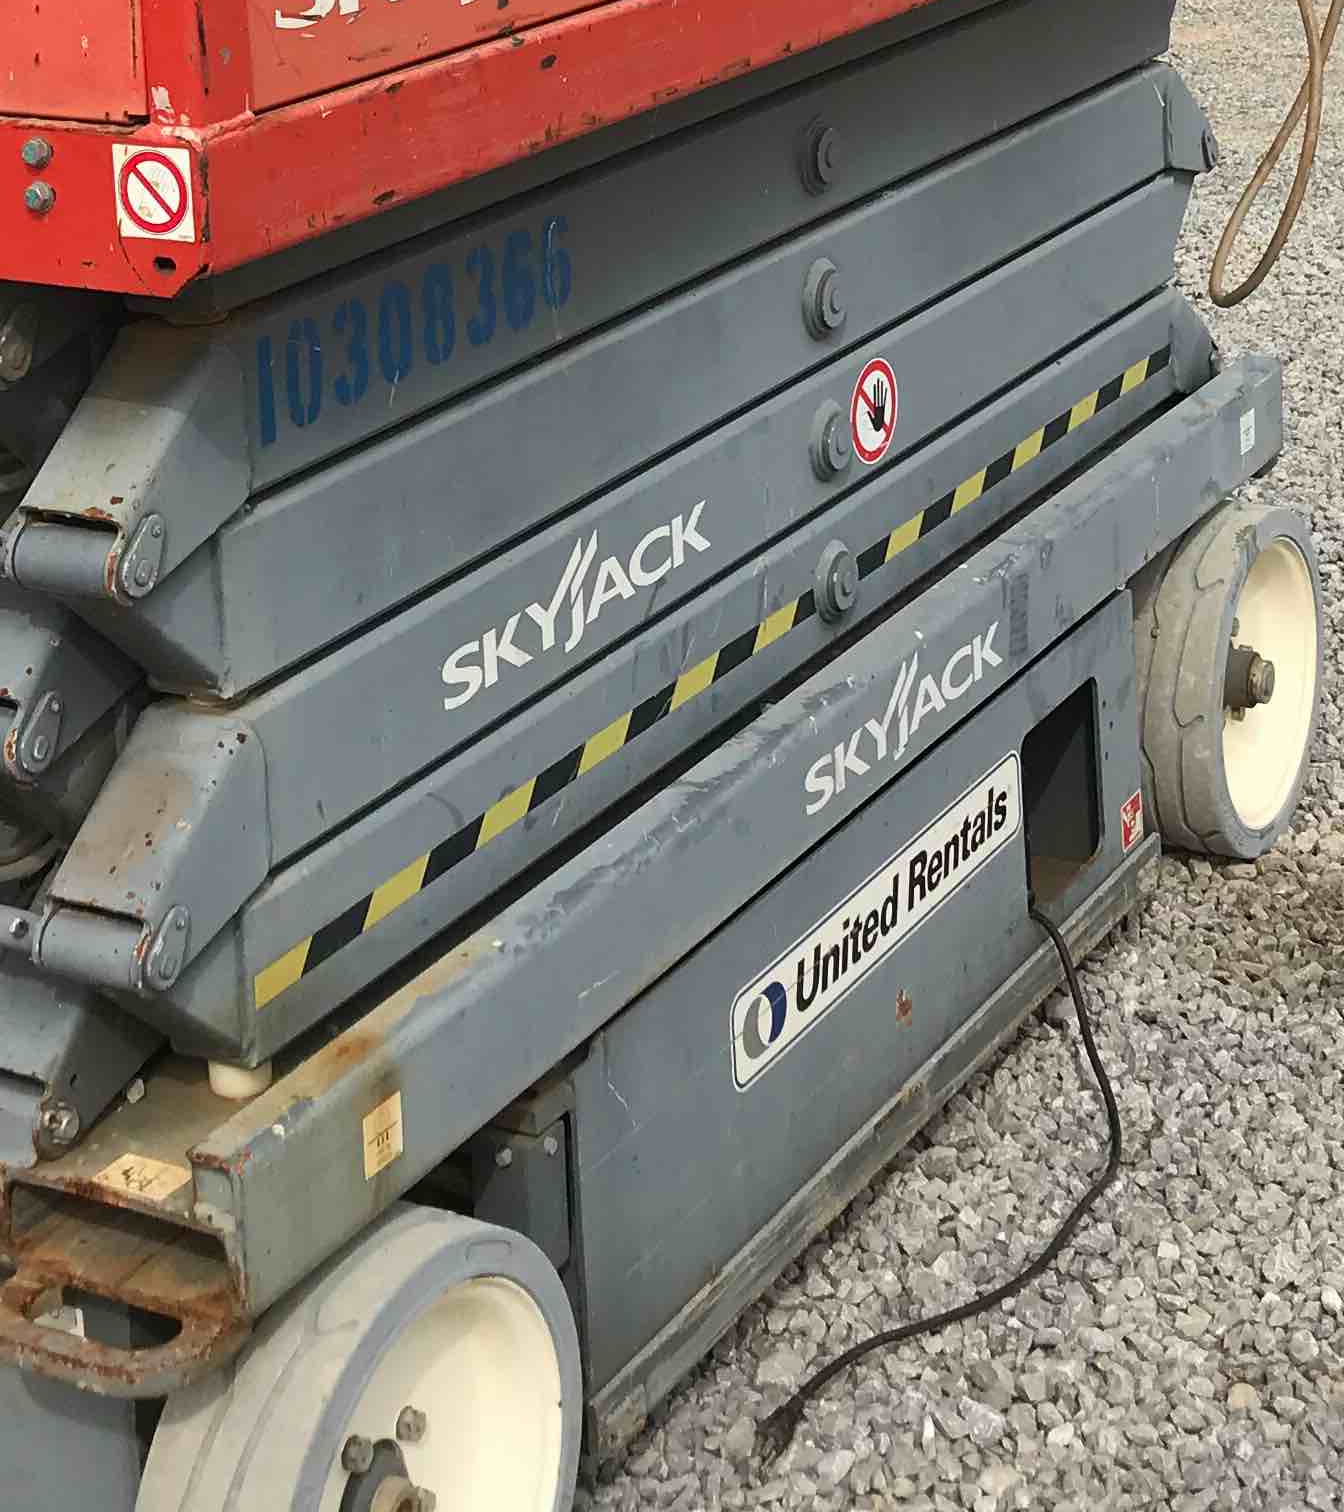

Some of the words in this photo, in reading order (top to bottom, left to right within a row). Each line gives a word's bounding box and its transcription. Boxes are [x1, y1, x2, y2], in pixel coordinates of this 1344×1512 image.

[257, 216, 571, 448] 10308366
[442, 500, 712, 710] SKYJACK
[805, 622, 1006, 816] SKYJACK
[796, 876, 899, 1013] United
[907, 787, 1008, 912] Rentals
